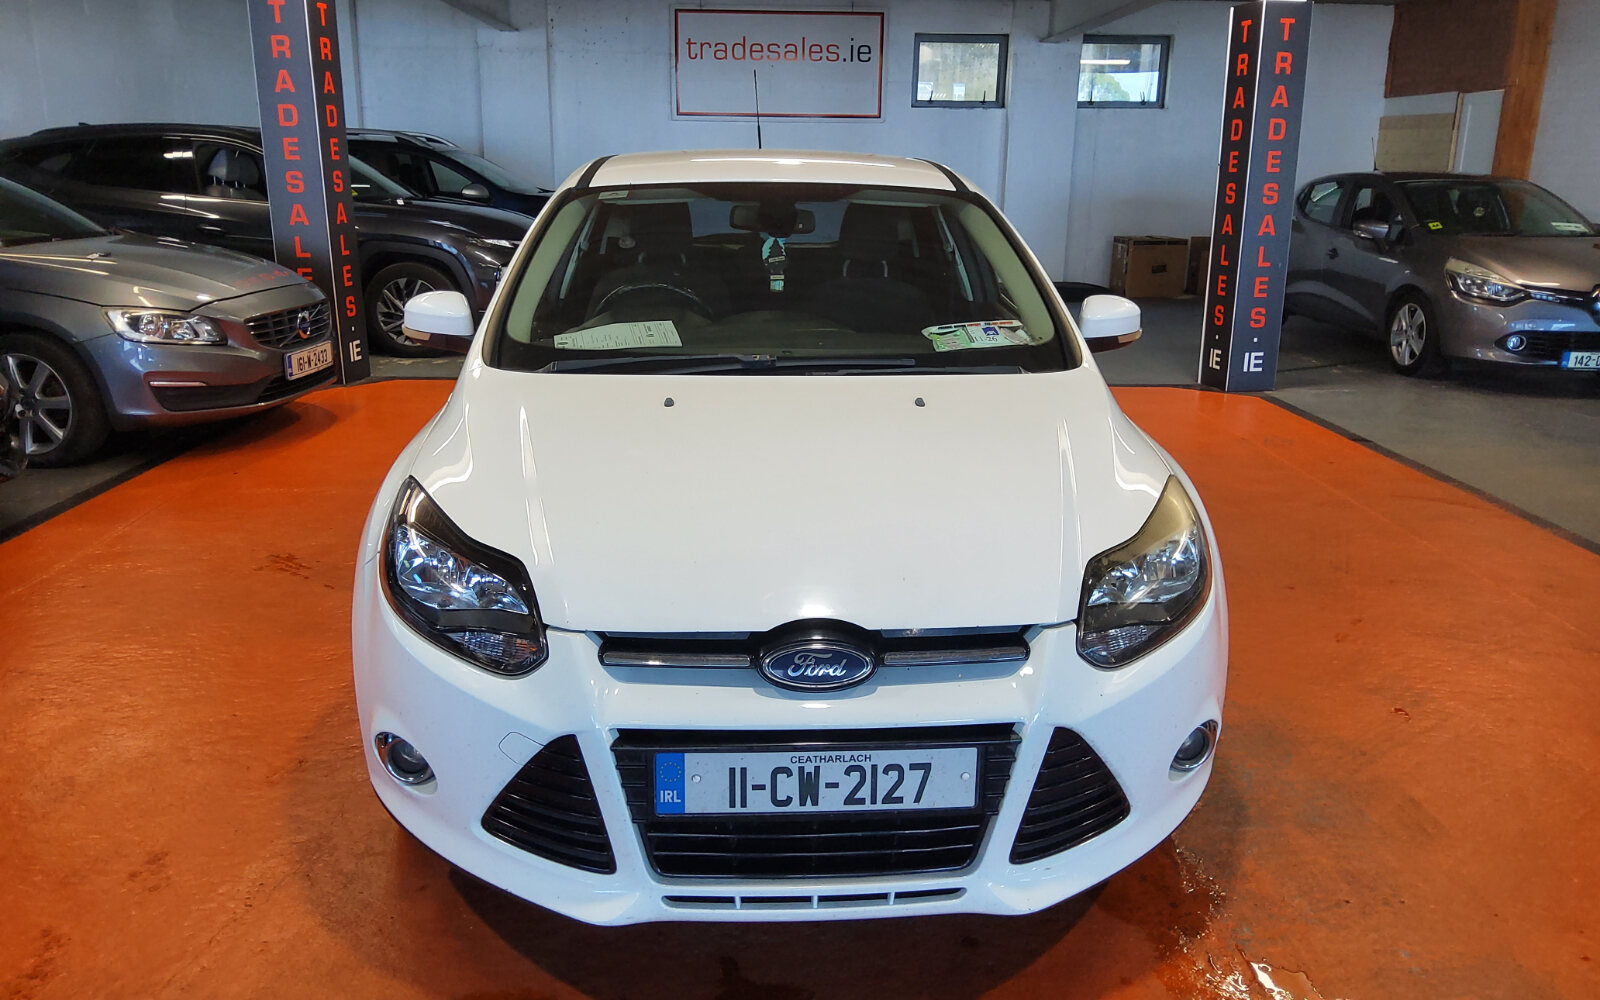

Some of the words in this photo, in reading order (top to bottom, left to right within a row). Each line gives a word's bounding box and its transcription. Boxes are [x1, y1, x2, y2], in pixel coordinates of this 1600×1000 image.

[685, 35, 872, 63] tradesales.ie
[787, 652, 847, 677] Ford
[790, 753, 872, 764] CEATHARLACH
[659, 790, 681, 803] IRL
[728, 762, 932, 809] 11-CW-2127
